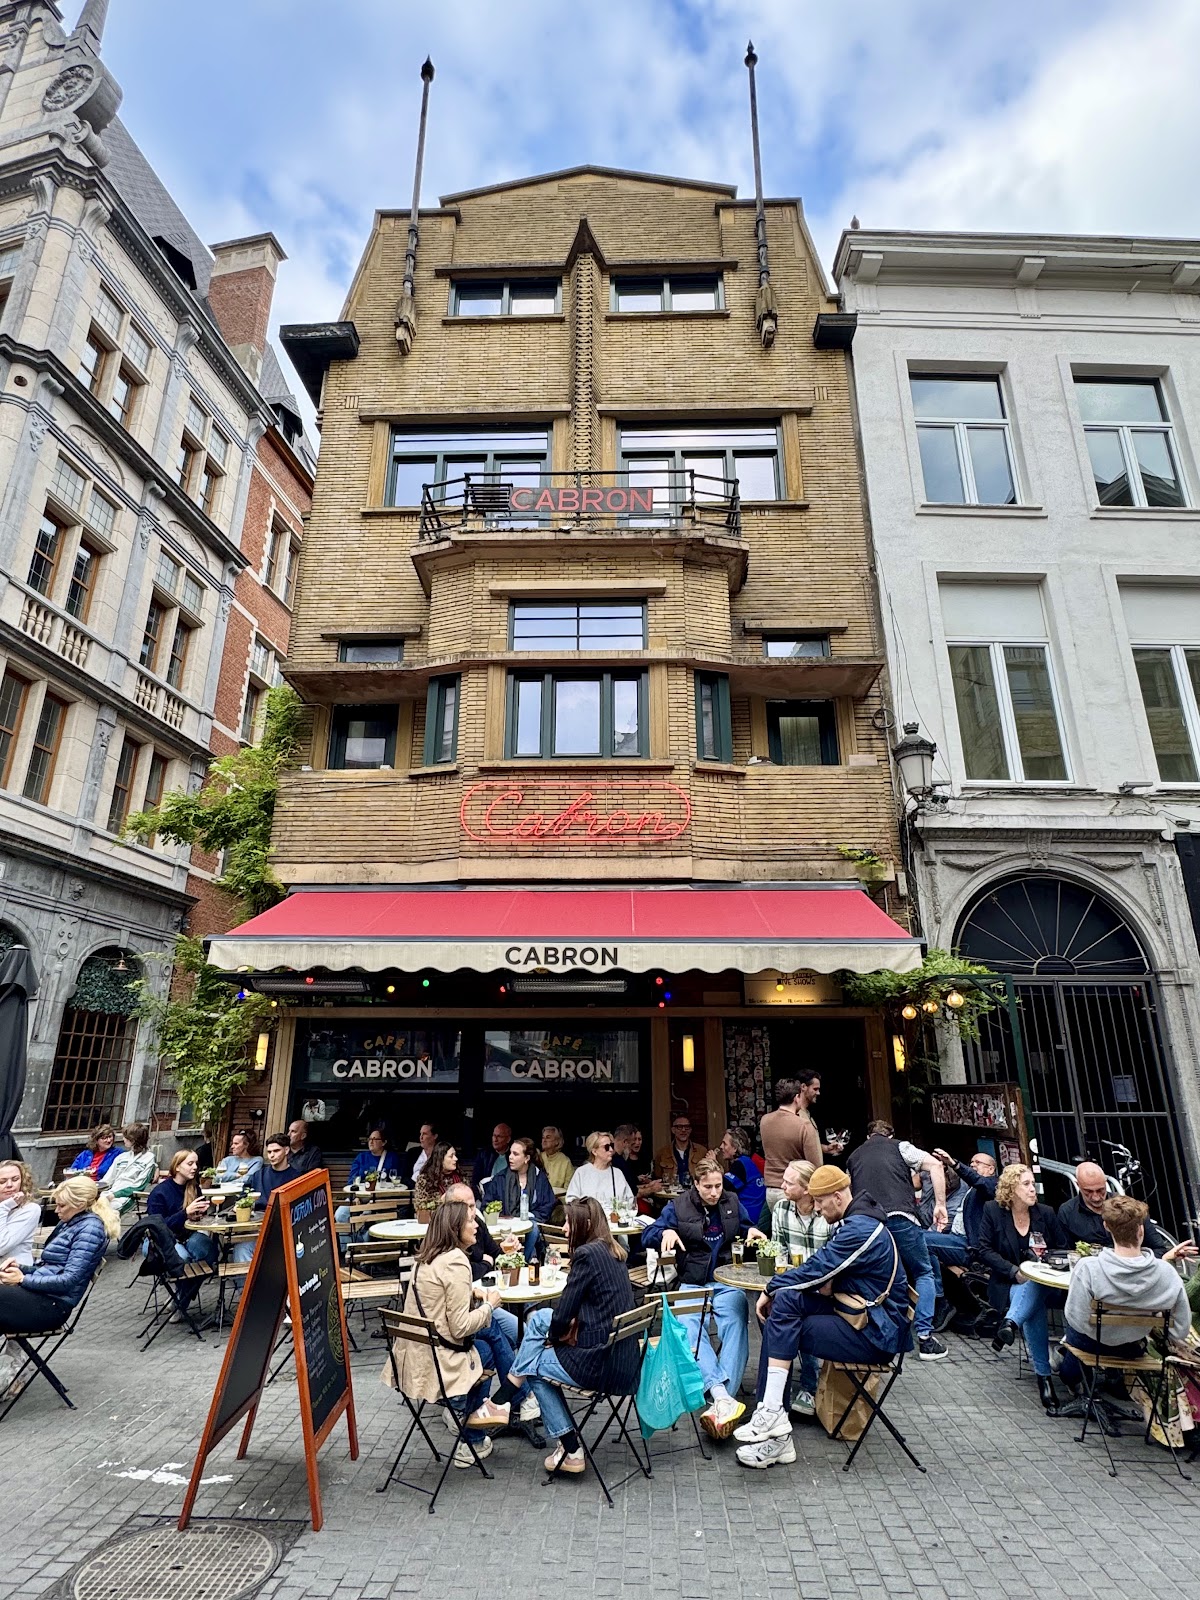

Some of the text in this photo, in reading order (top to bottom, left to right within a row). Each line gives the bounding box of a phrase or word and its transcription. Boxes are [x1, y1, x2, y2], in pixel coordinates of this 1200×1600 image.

[510, 489, 653, 511] CABRON
[485, 791, 680, 836] Cabron
[505, 946, 618, 966] CABRON
[332, 1059, 433, 1078] CABRON
[510, 1059, 612, 1079] CABRON
